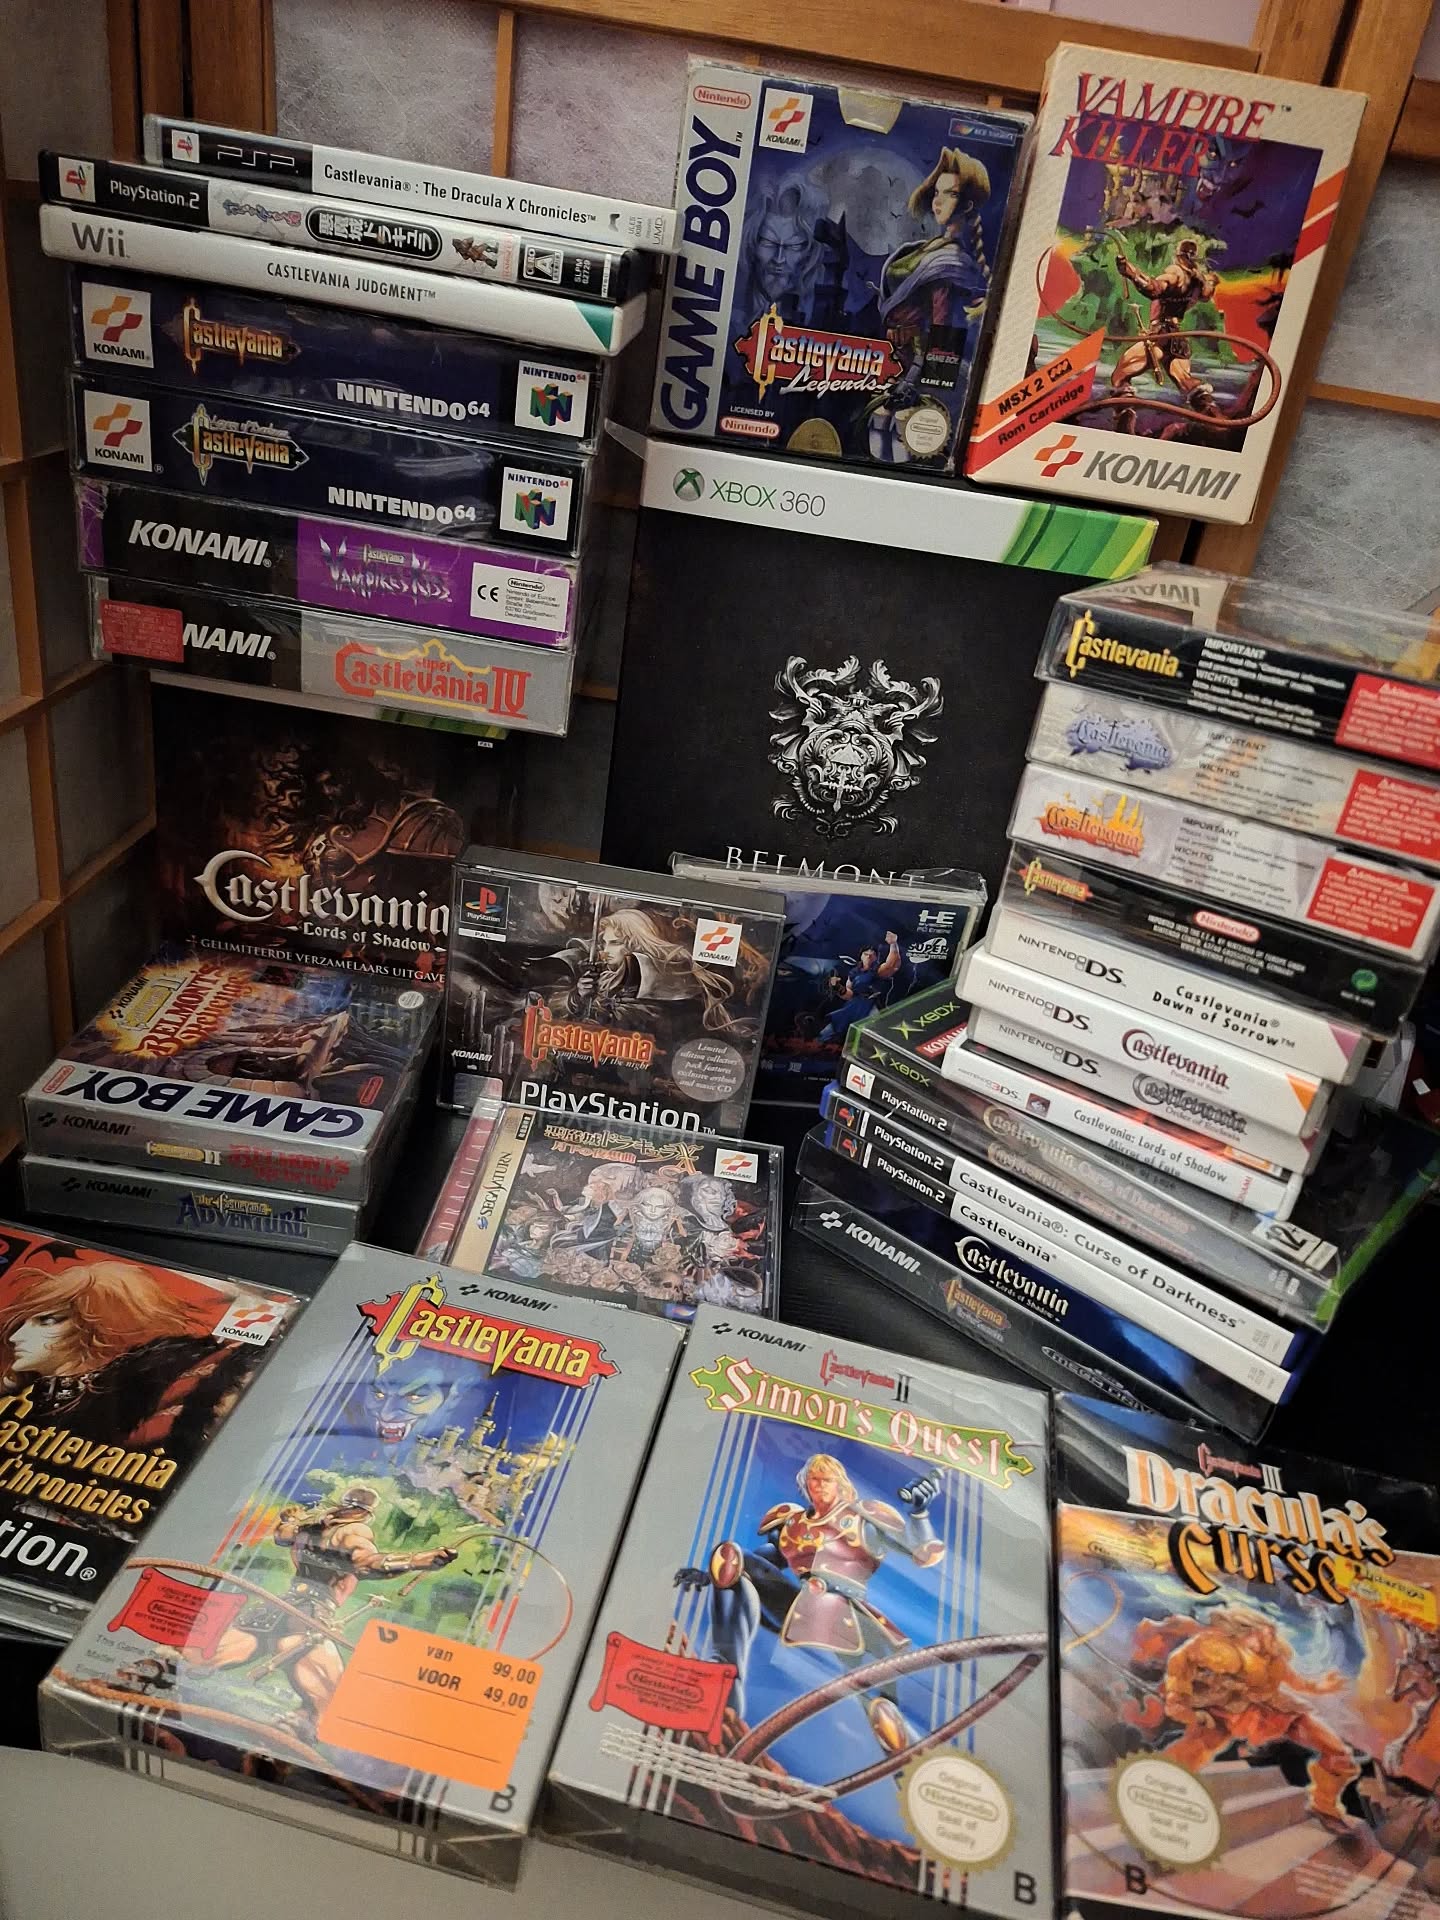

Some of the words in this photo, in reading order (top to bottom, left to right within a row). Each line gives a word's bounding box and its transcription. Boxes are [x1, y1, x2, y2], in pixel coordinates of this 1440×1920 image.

[697, 89, 748, 107] Nintendo
[217, 144, 298, 174] PSP
[1049, 114, 1211, 177] KILLER
[423, 182, 447, 199] The
[451, 187, 502, 209] Dracula
[506, 197, 515, 210] X
[71, 222, 126, 258] Wii
[267, 262, 349, 289] CASTLEVANIA
[93, 343, 145, 360] KONAMI
[183, 299, 283, 374] Castlevania
[660, 255, 725, 430] GAME
[753, 302, 884, 404] Castlevania
[780, 365, 890, 399] Legends
[921, 377, 940, 386] GAME
[998, 385, 1032, 415] MSX
[1034, 378, 1045, 392] 2
[730, 405, 764, 416] LICENSED
[998, 423, 1026, 446] Rom
[1029, 384, 1084, 424] Cartridge
[192, 404, 290, 486] Castlevania
[724, 420, 777, 436] Nintendo
[95, 448, 144, 464] KONAMI
[1083, 449, 1242, 501] KONAMI
[709, 479, 778, 511] XBOX
[779, 490, 827, 518] 360
[1204, 638, 1267, 660] IMPORTANT
[335, 642, 488, 706] Castlevania
[487, 666, 531, 719] IV
[1046, 806, 1139, 849] Castlevania
[1182, 816, 1239, 838] IMPORTANT
[193, 849, 450, 937] Castlevania
[1024, 857, 1085, 899] Castlevania
[467, 911, 500, 923] PlayStation
[303, 921, 347, 940] Lords
[352, 931, 367, 944] of
[372, 932, 431, 952] Shadow
[475, 931, 490, 939] PAL
[908, 943, 949, 954] SUPER
[201, 938, 293, 962] GELIMITEERDE
[295, 952, 390, 976] VERZAMELAARS
[392, 967, 446, 984] UITGAVE
[118, 976, 150, 1009] KONAMI
[1152, 991, 1194, 1018] Dawn
[1200, 1009, 1219, 1026] of
[912, 1001, 961, 1028] XBOX
[523, 998, 653, 1073] Castlevania
[452, 1049, 492, 1063] KONAMI
[551, 1049, 594, 1063] Symphony
[600, 1056, 609, 1065] of
[610, 1057, 623, 1067] the
[624, 1059, 650, 1071] night
[890, 1058, 932, 1087] XBOX
[1121, 1028, 1230, 1088] Castlevania
[56, 1070, 194, 1113] BOY
[62, 1114, 132, 1136] KONAMI
[183, 1088, 364, 1139] GAME
[1107, 1138, 1140, 1161] Mirror
[1138, 1134, 1167, 1157] Lords
[1169, 1149, 1184, 1163] of
[1185, 1155, 1229, 1183] Shadow
[86, 1179, 153, 1199] KONAMI
[845, 1222, 921, 1275] KONAMI
[1073, 1232, 1123, 1267] Curse
[1127, 1262, 1149, 1282] of
[954, 1235, 1070, 1317] Castlevania
[483, 1287, 553, 1311] KONAMI
[945, 1278, 1005, 1328] Castlevania
[220, 1325, 265, 1343] KONAMI
[372, 1270, 591, 1379] Castlevania
[736, 1326, 807, 1353] KONAMI
[892, 1369, 913, 1404] II
[719, 1356, 875, 1437] Simon's
[888, 1408, 1003, 1478] Quest
[1121, 1445, 1397, 1567] Dracula's
[1168, 1517, 1349, 1605] Curse
[426, 1645, 454, 1663] van
[416, 1665, 462, 1692] VOOR
[1013, 1871, 1038, 1905] B
[1124, 1863, 1149, 1896] B
